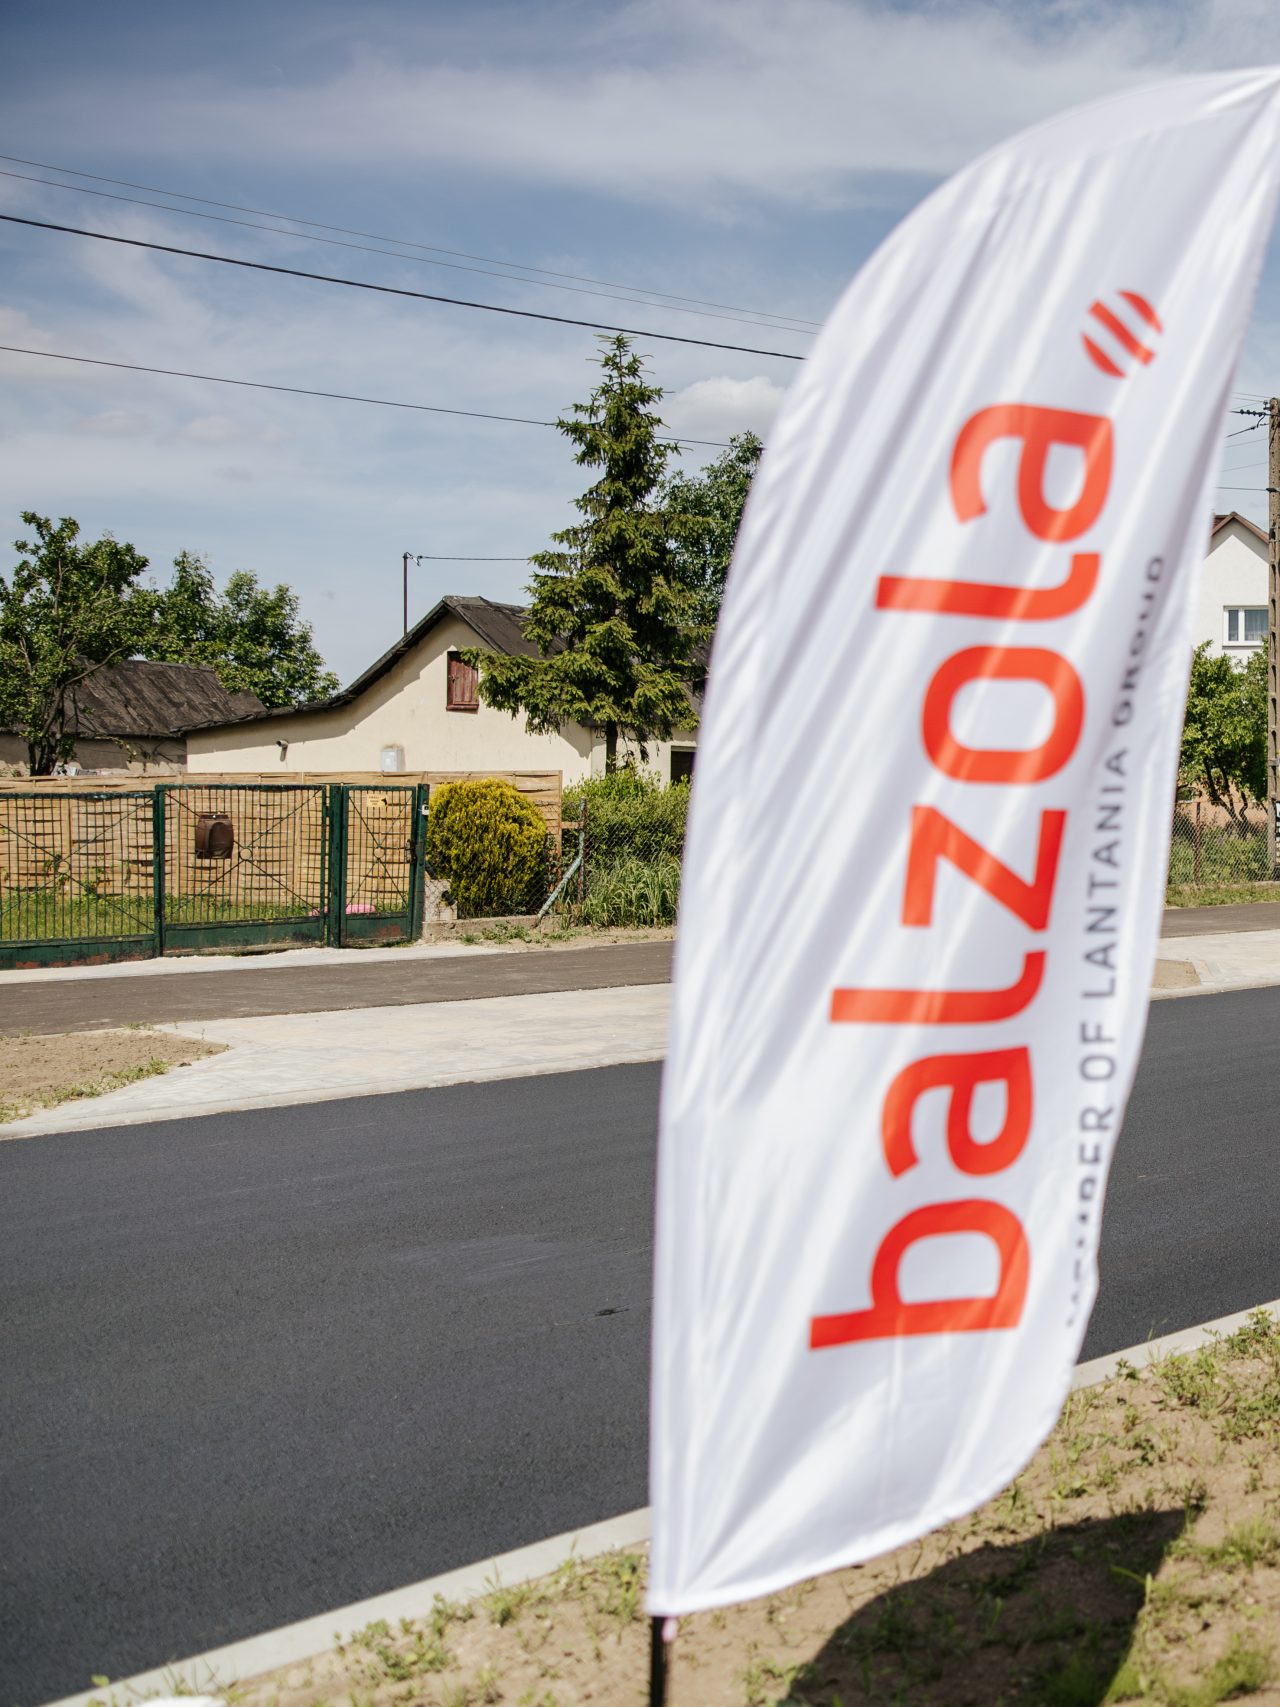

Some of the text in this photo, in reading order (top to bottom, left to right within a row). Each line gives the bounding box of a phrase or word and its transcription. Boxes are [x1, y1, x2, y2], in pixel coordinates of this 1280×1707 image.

[809, 404, 1112, 1350] balzola
[1081, 749, 1128, 999] LANTANIA
[1079, 1020, 1118, 1082] OF
